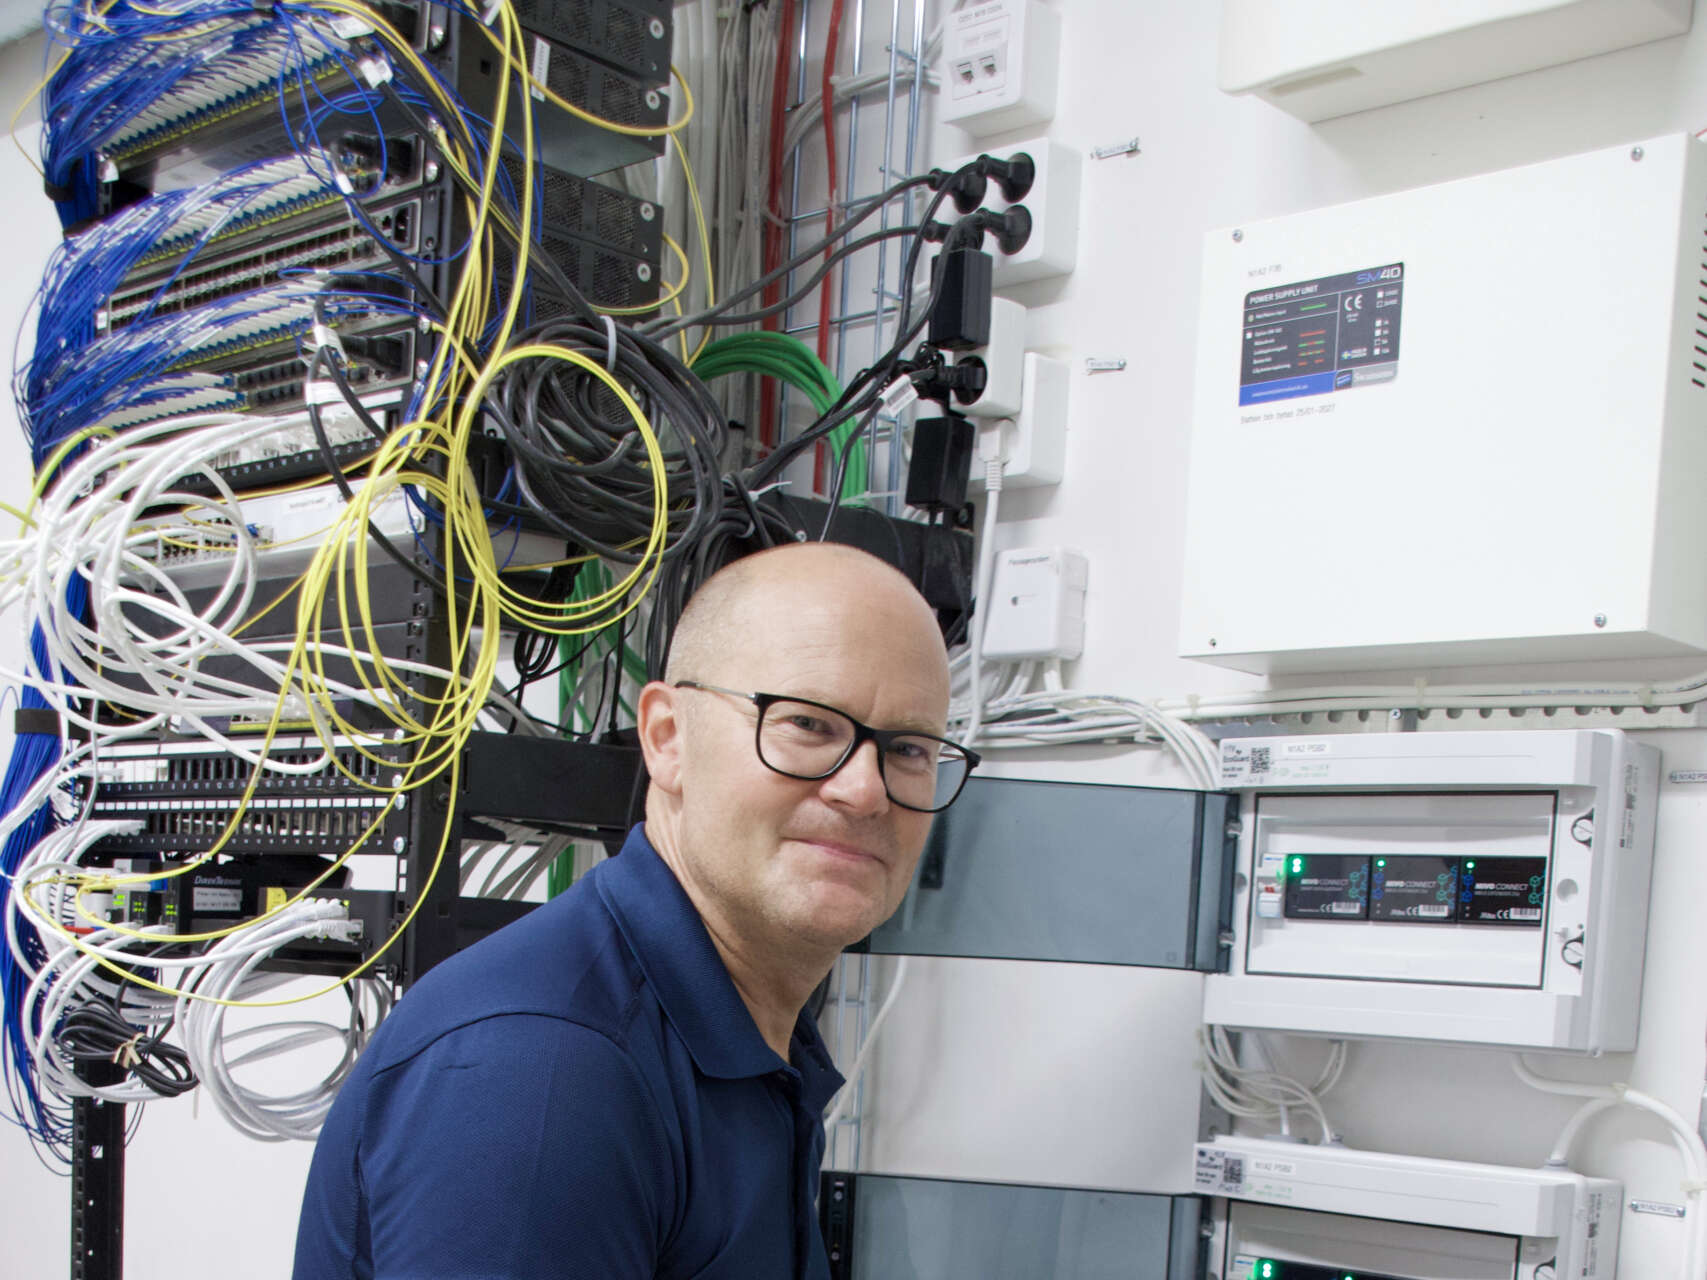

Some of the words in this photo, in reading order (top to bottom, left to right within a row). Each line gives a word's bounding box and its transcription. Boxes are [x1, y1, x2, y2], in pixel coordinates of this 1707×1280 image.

[1356, 267, 1400, 284] SM40
[1250, 294, 1273, 304] POWER
[1274, 289, 1300, 301] SUPPLY
[1301, 284, 1319, 294] UNIT
